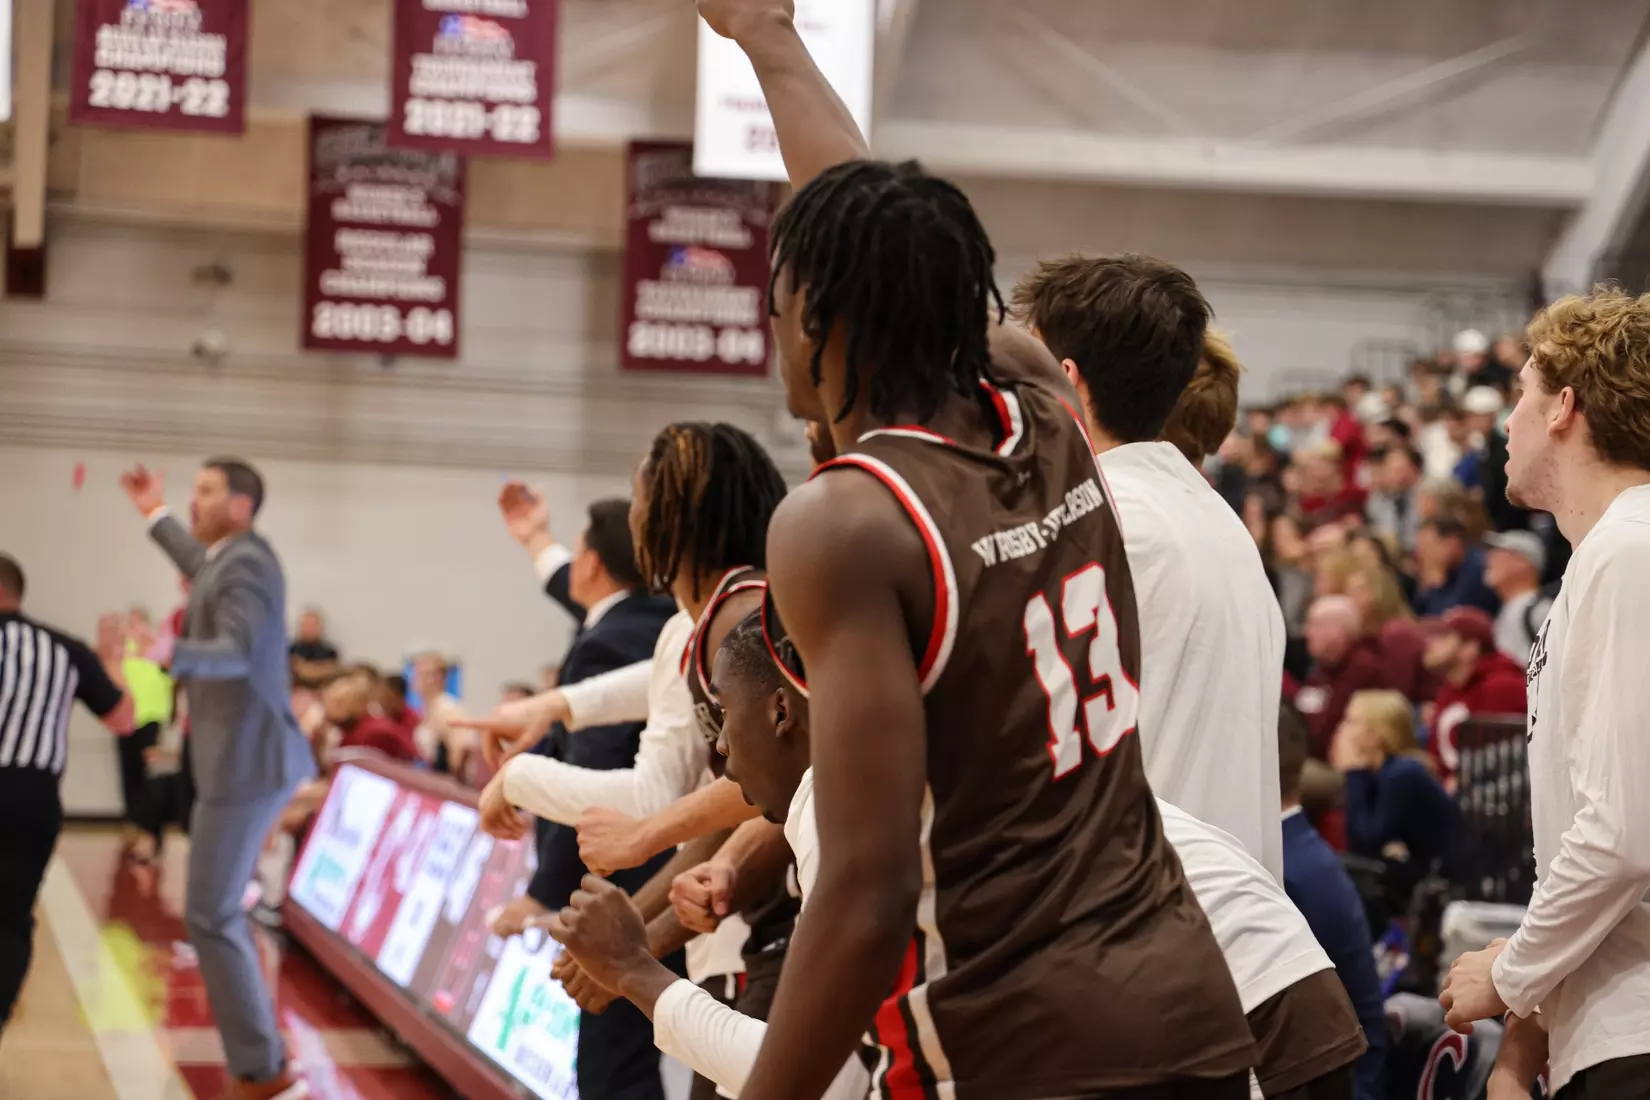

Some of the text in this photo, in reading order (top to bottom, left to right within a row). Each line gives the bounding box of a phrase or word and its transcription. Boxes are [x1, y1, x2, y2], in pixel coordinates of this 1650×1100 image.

[88, 69, 230, 118] 2021-22
[312, 301, 453, 346] 2003-04
[1024, 561, 1140, 782] 13
